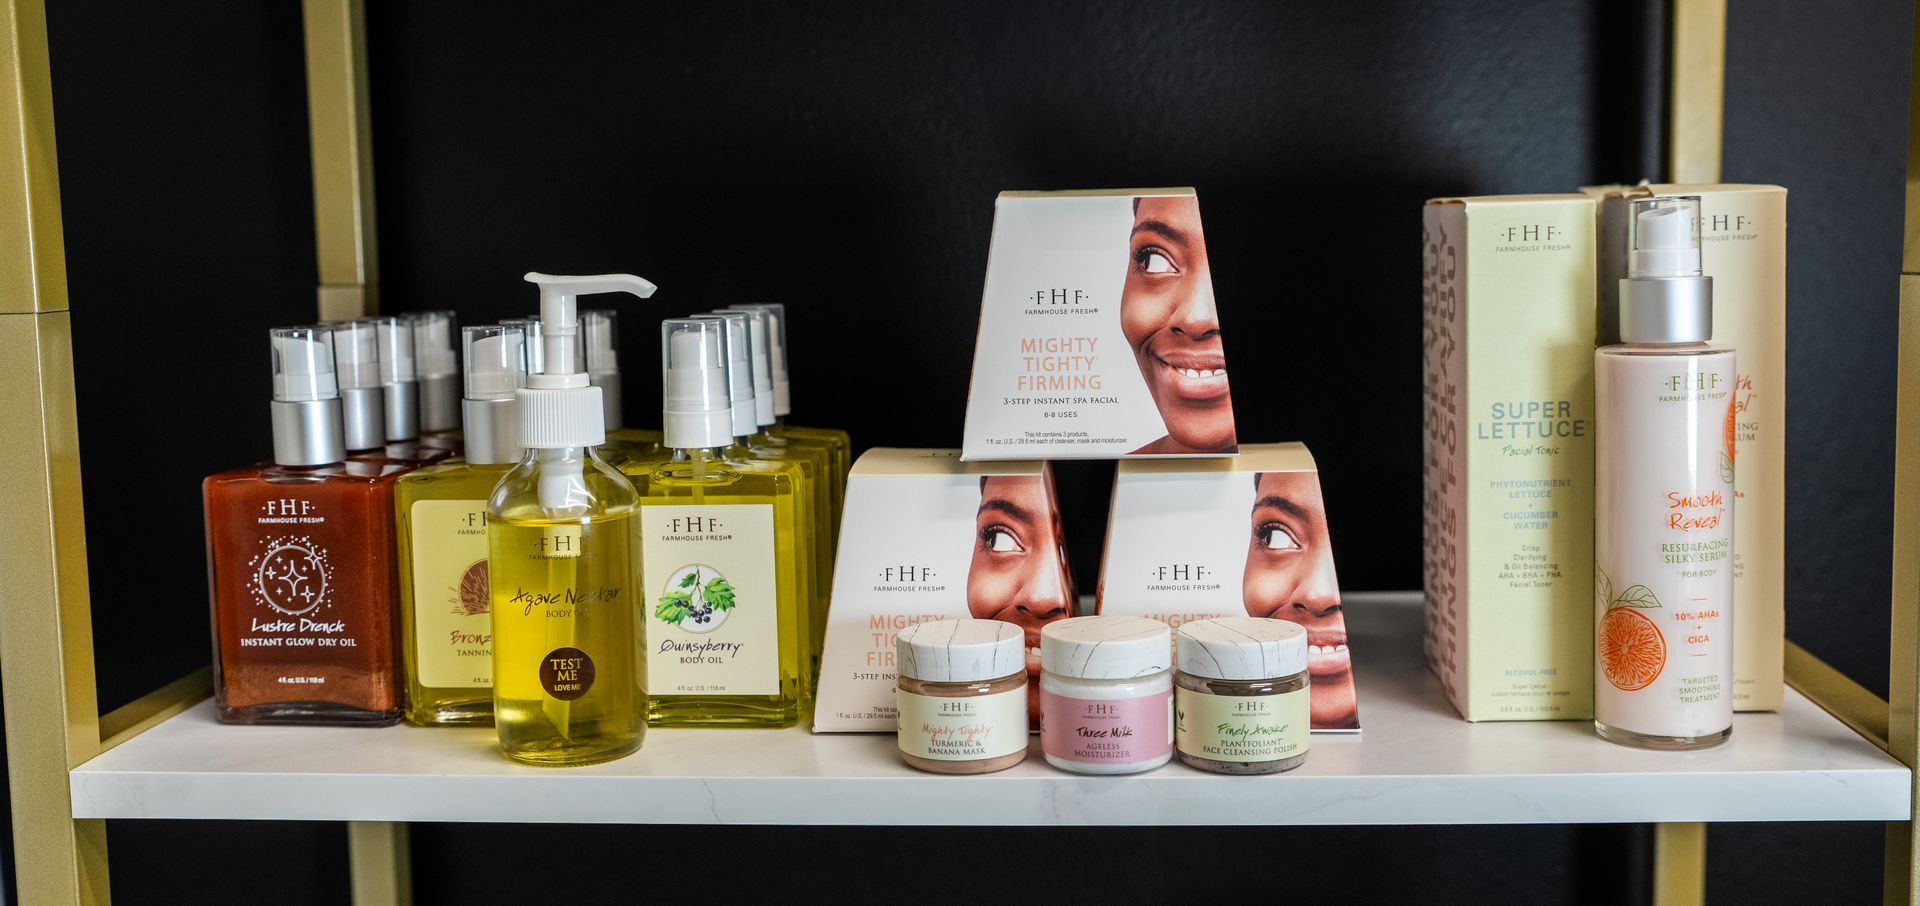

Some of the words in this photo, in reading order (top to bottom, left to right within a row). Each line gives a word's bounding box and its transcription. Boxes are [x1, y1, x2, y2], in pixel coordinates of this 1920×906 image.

[1447, 244, 1456, 358] YOU
[1020, 337, 1098, 353] MIGHTY
[1023, 356, 1096, 372] TIGHTY
[1018, 375, 1101, 391] FIRMING
[1491, 401, 1571, 420] SUPER
[1447, 384, 1456, 486] FOR
[1478, 420, 1584, 440] LETTUCE
[1502, 444, 1534, 456] Facial
[1535, 443, 1560, 456] Tonic
[1490, 480, 1571, 489] PHYTONUTRIENT
[1509, 490, 1552, 498] LETTUCE
[1667, 490, 1723, 508] Smooth
[1504, 511, 1558, 520] CUCUMBER
[1669, 510, 1721, 532] Reveal
[1514, 522, 1548, 530] WATER
[1522, 545, 1540, 553] Crisp
[1662, 541, 1729, 553] RESURFACING
[1513, 554, 1547, 562] Clarifying
[1665, 554, 1695, 563] SILKY
[1699, 551, 1727, 562] SERUM
[1523, 563, 1558, 571] Balancing
[1699, 569, 1717, 577] BODY
[510, 587, 560, 616] Agave
[1447, 506, 1456, 700] THINGS
[1675, 613, 1695, 621] 10%
[1698, 610, 1719, 619] AHAs
[252, 618, 296, 632] Lustre
[300, 618, 345, 634] Drench
[241, 638, 282, 646] INSTANT
[286, 638, 315, 646] GLOW
[318, 638, 337, 646] DRY
[340, 638, 356, 647] OIL
[1688, 636, 1710, 644] CICA
[551, 658, 583, 670] TEST
[557, 671, 577, 681] ME
[1683, 675, 1718, 684] TARGETED
[1679, 684, 1721, 695] SMOOTHING
[1680, 693, 1720, 703] TREATMENT
[922, 723, 955, 741] Mighty
[1076, 727, 1107, 738] Three
[1111, 725, 1133, 737] Milk
[1217, 723, 1248, 743] Finely
[928, 747, 960, 755] BANANA
[1223, 747, 1271, 756] CLEANSING
[1274, 744, 1297, 754] POLISH
